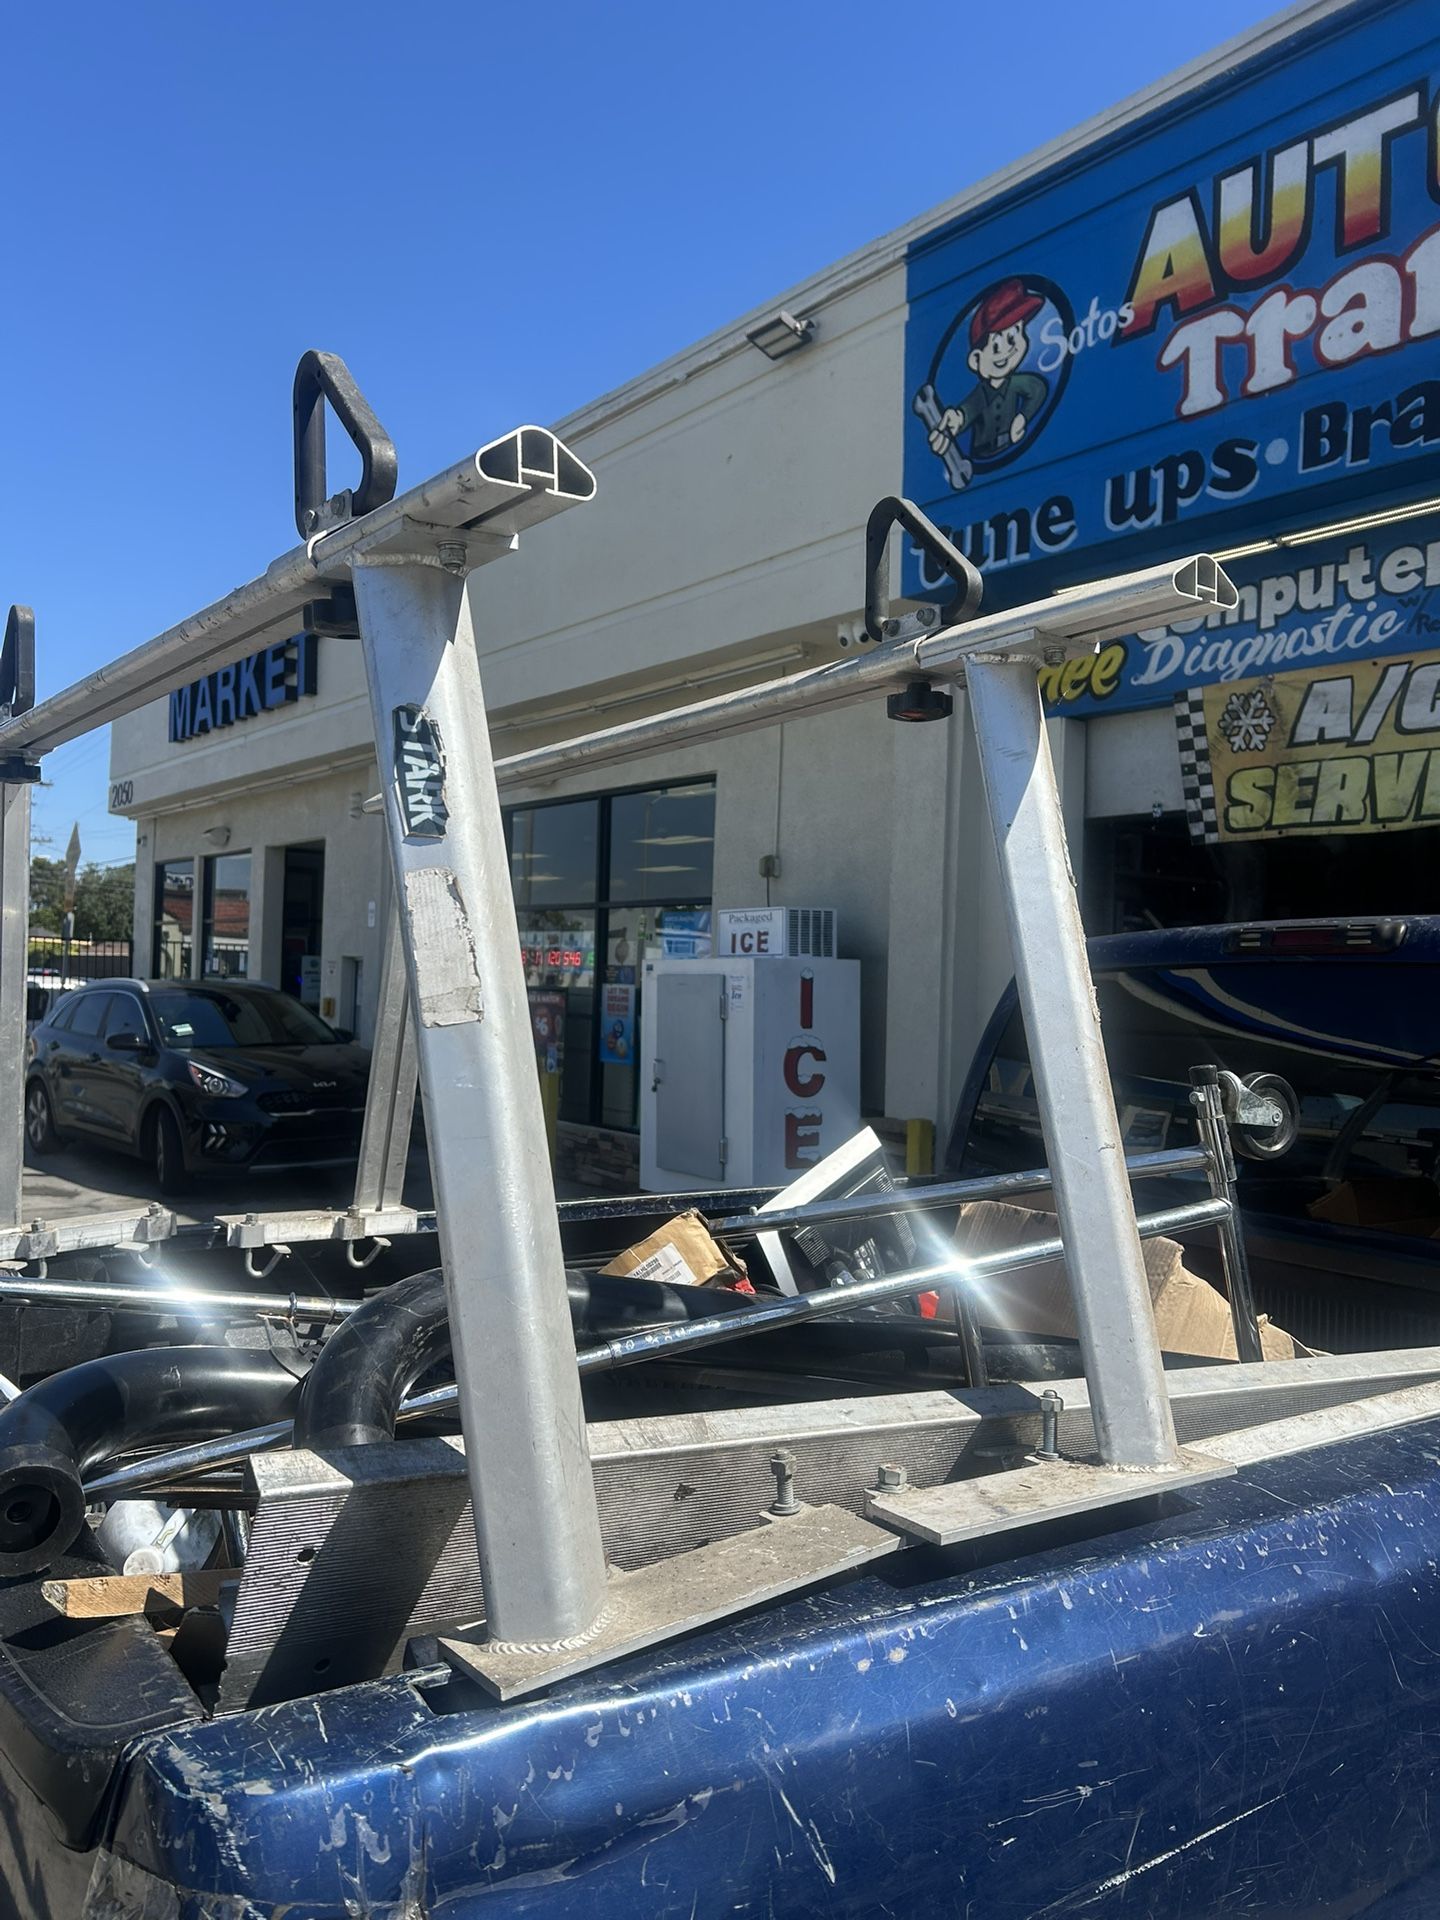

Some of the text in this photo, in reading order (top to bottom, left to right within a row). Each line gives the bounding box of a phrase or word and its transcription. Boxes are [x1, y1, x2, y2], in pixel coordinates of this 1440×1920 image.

[1112, 83, 1440, 345] AUT
[1038, 296, 1135, 373] Sotos
[1104, 438, 1261, 531] ups
[1137, 541, 1440, 642] mpute
[168, 631, 314, 743] MARKET
[1130, 601, 1406, 686] Diagnostic
[728, 911, 773, 925] Packaged
[730, 930, 770, 954] ICE
[783, 966, 827, 1169] ICE
